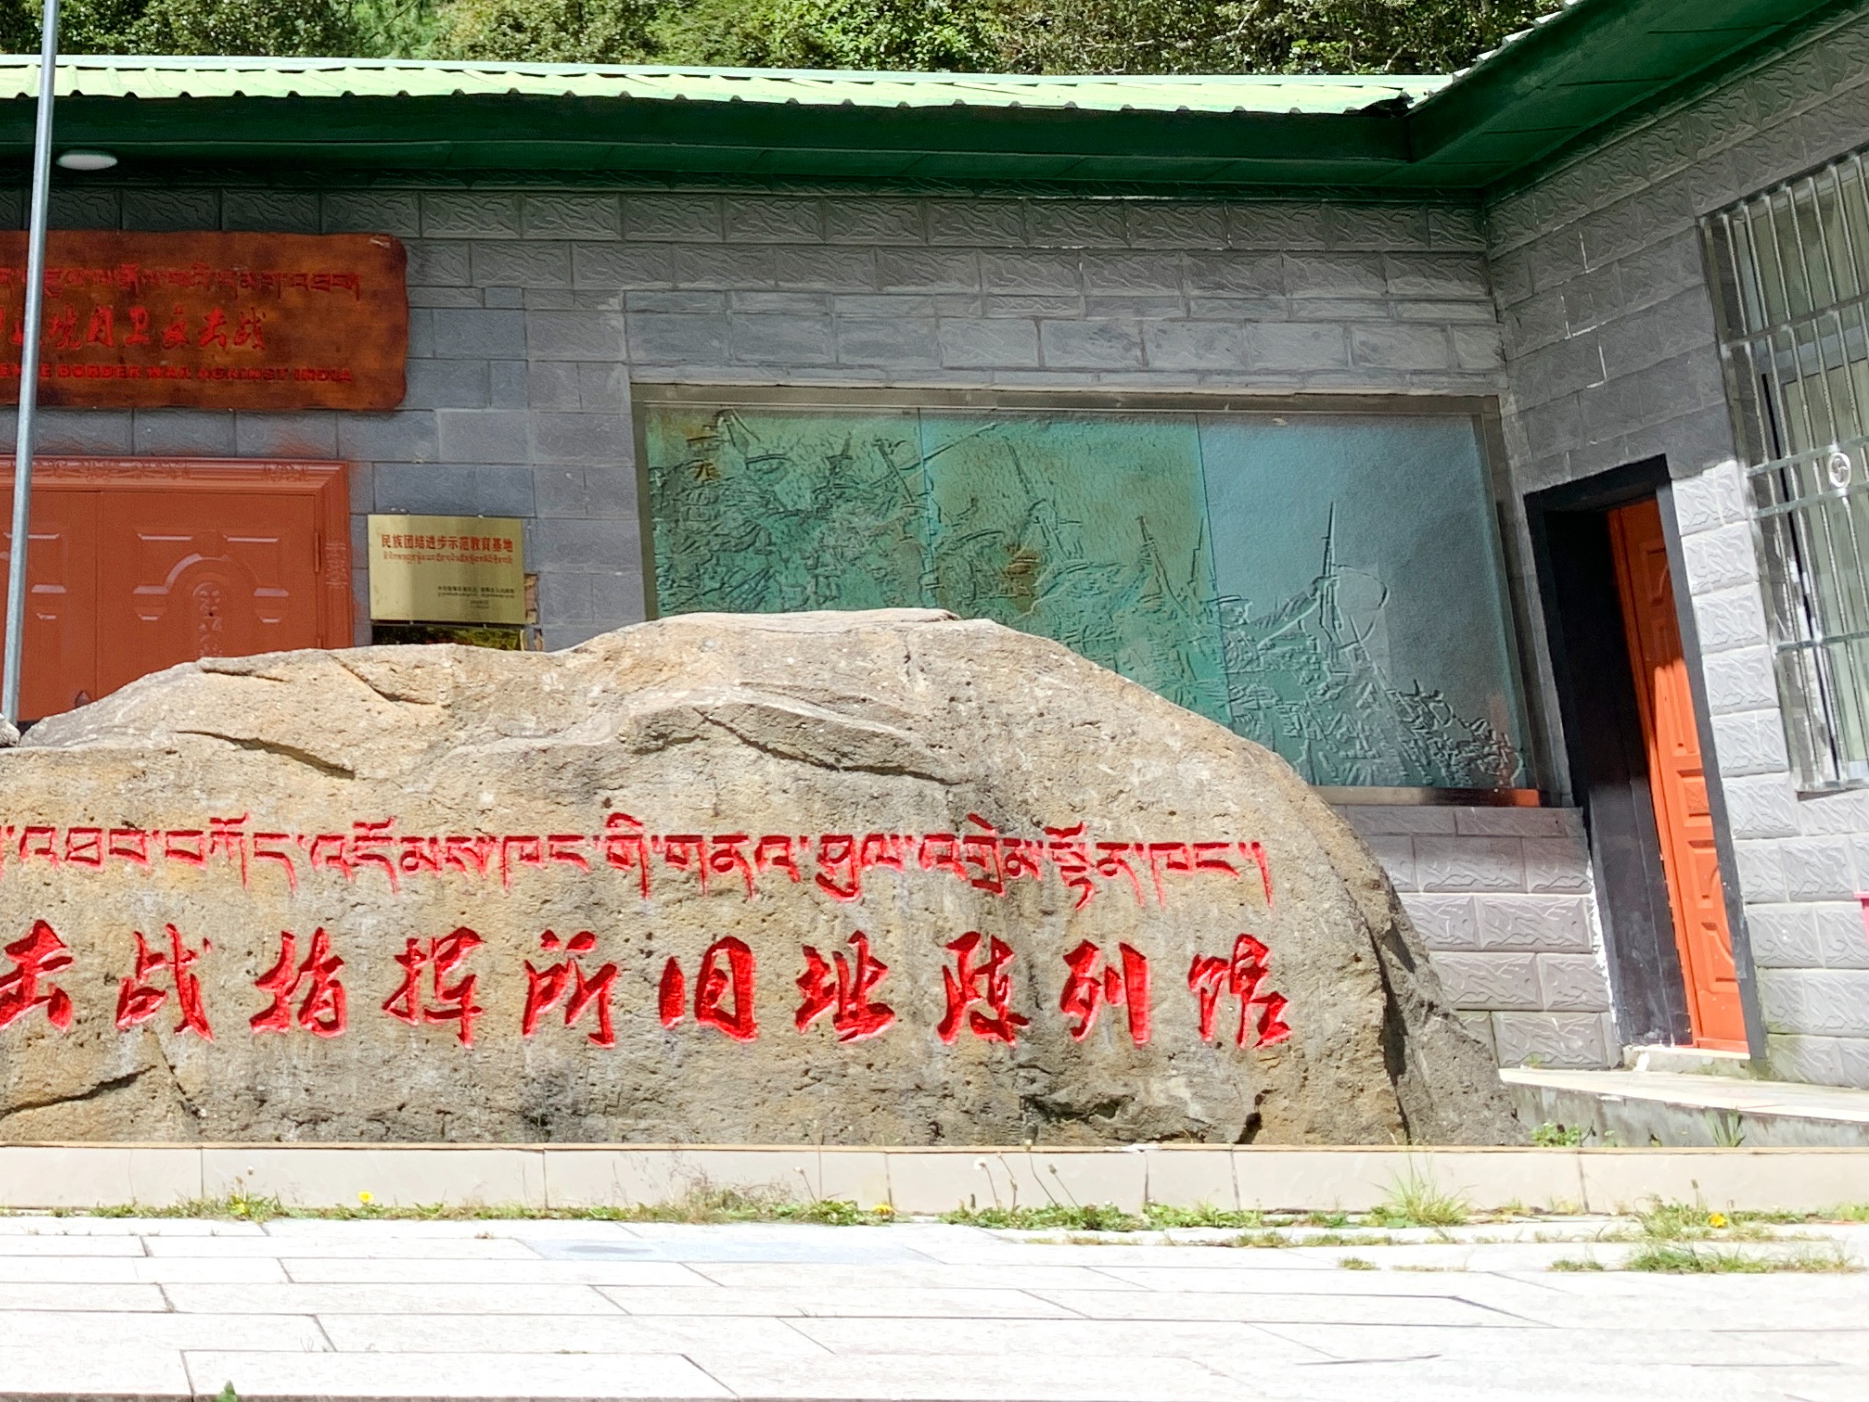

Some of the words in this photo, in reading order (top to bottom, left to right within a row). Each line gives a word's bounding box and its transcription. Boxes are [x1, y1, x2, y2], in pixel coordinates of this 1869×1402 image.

[58, 364, 141, 379] BORDER
[147, 366, 191, 380] WAR
[197, 367, 289, 381] AGAINST
[294, 368, 352, 382] INDIA
[381, 534, 514, 553] 民族团结进步示范教育基地
